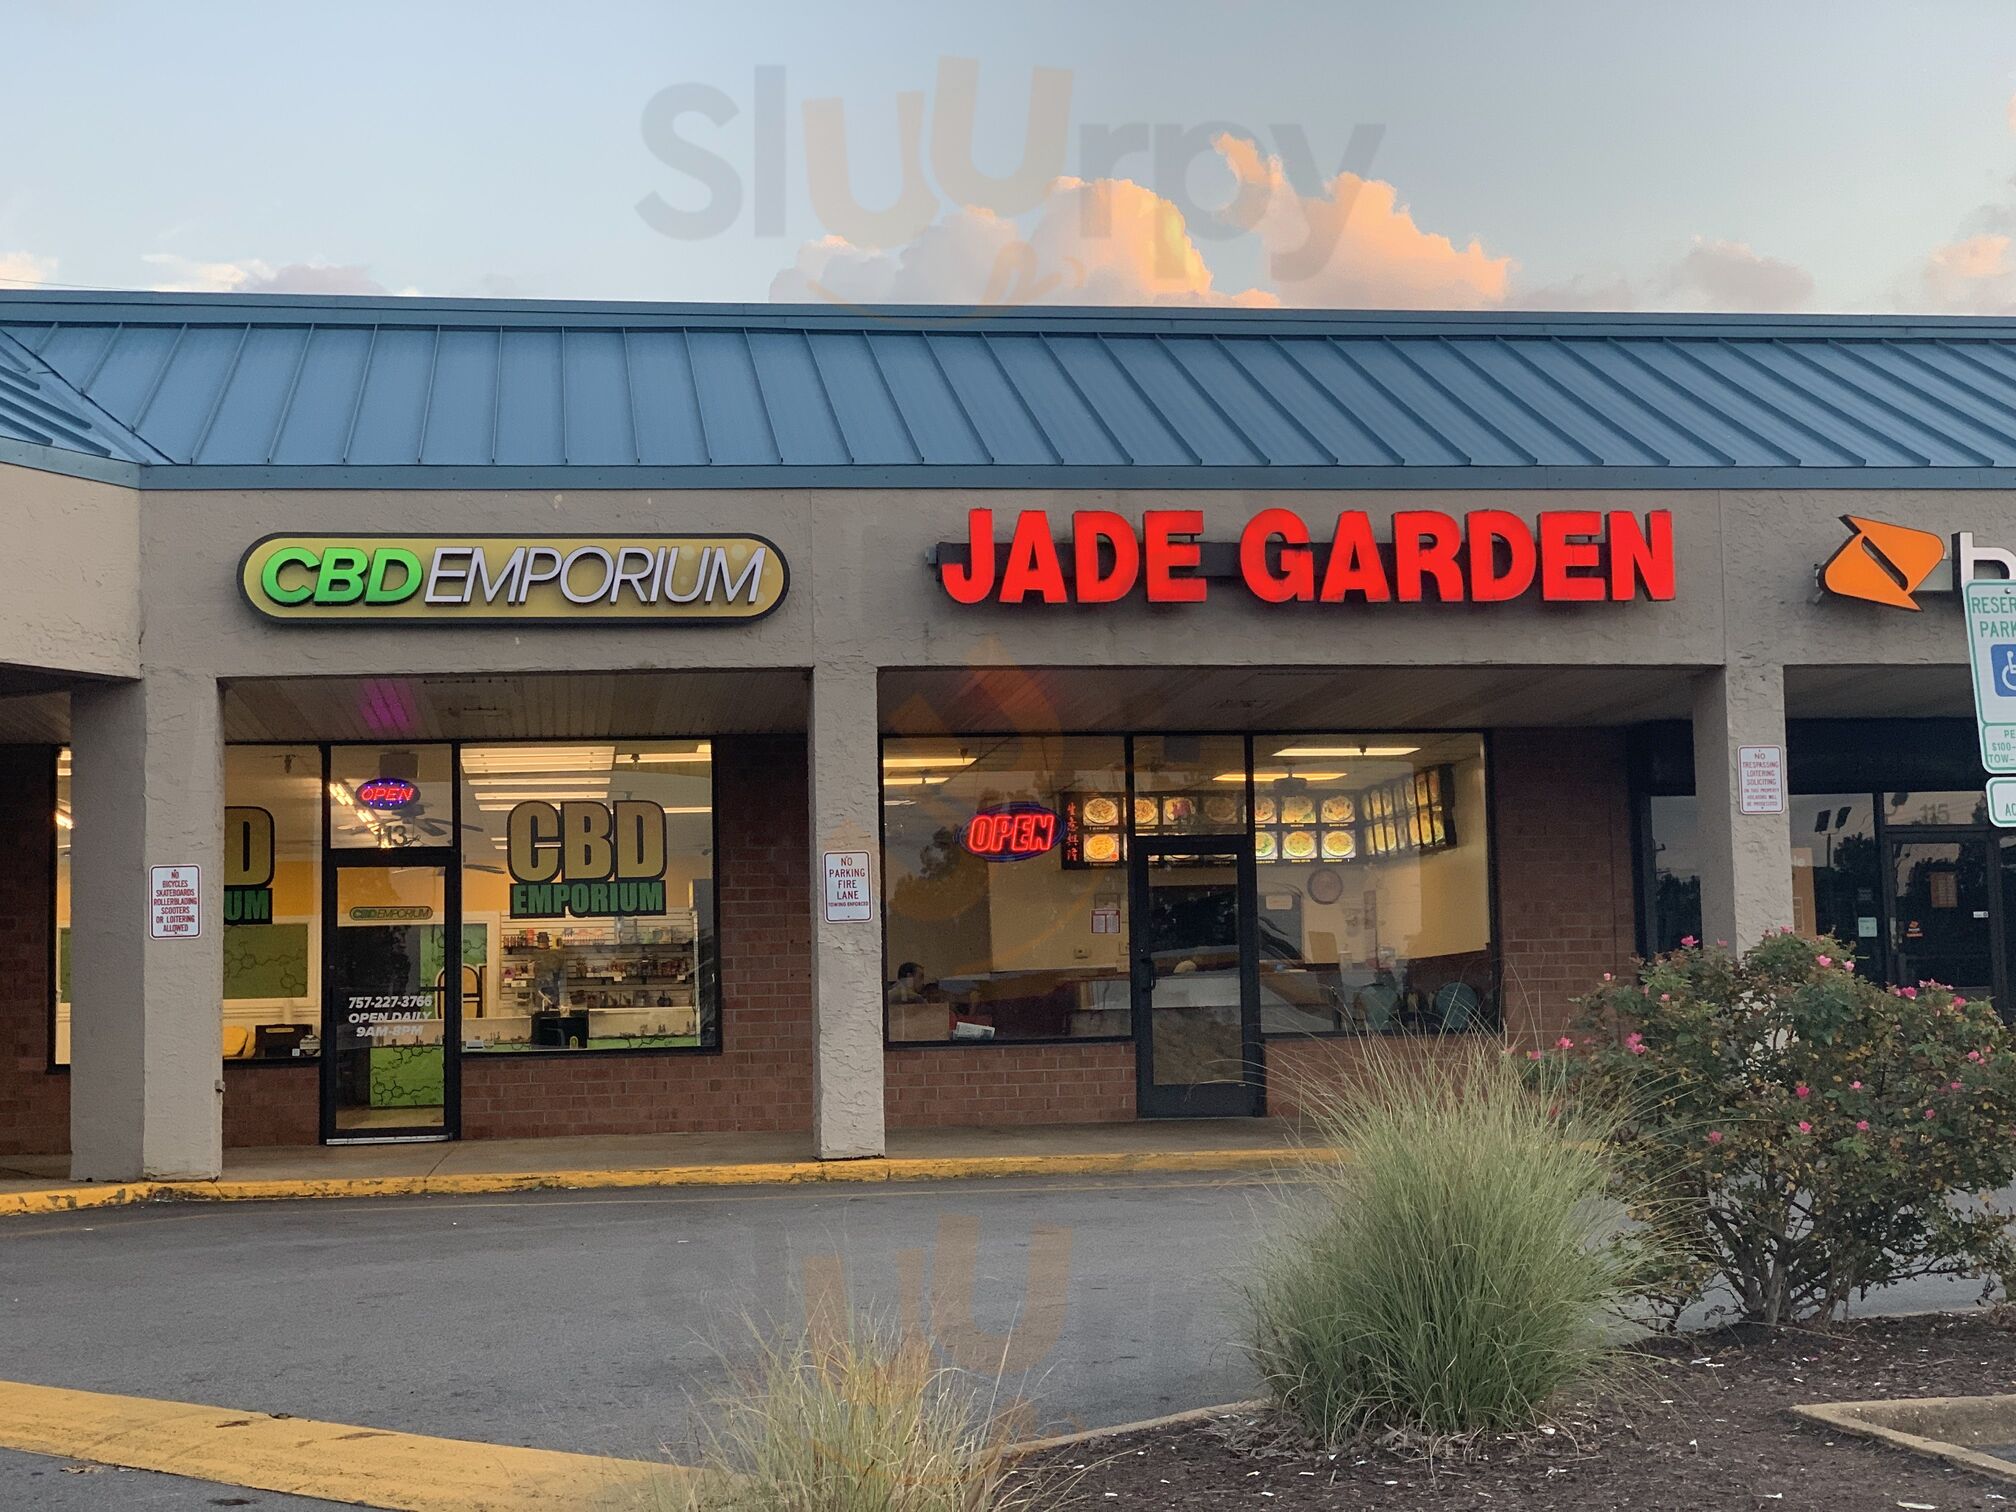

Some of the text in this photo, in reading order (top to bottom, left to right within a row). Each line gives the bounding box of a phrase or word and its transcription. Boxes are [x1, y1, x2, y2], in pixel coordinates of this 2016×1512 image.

[942, 508, 1676, 605] JADE GARDEN
[1754, 752, 1766, 760] NO
[1743, 761, 1779, 769] TRESPASSING
[361, 788, 414, 801] OPEN
[968, 813, 1055, 852] OPEN
[507, 799, 667, 883] CBD
[841, 857, 853, 867] NO
[829, 868, 866, 878] PARKING
[162, 880, 188, 888] BICYCLES
[838, 880, 857, 889] FIRE
[156, 889, 195, 897] SKATEBOARDS
[837, 890, 859, 900] LANE
[153, 898, 197, 906] ROLLERBLADING
[511, 882, 665, 918] EMPORIUM
[161, 906, 190, 915] SCOOTERS
[156, 914, 195, 924] OR LOITERING
[163, 924, 189, 932] ALLOWED
[348, 1011, 433, 1024] OPEN DAILY
